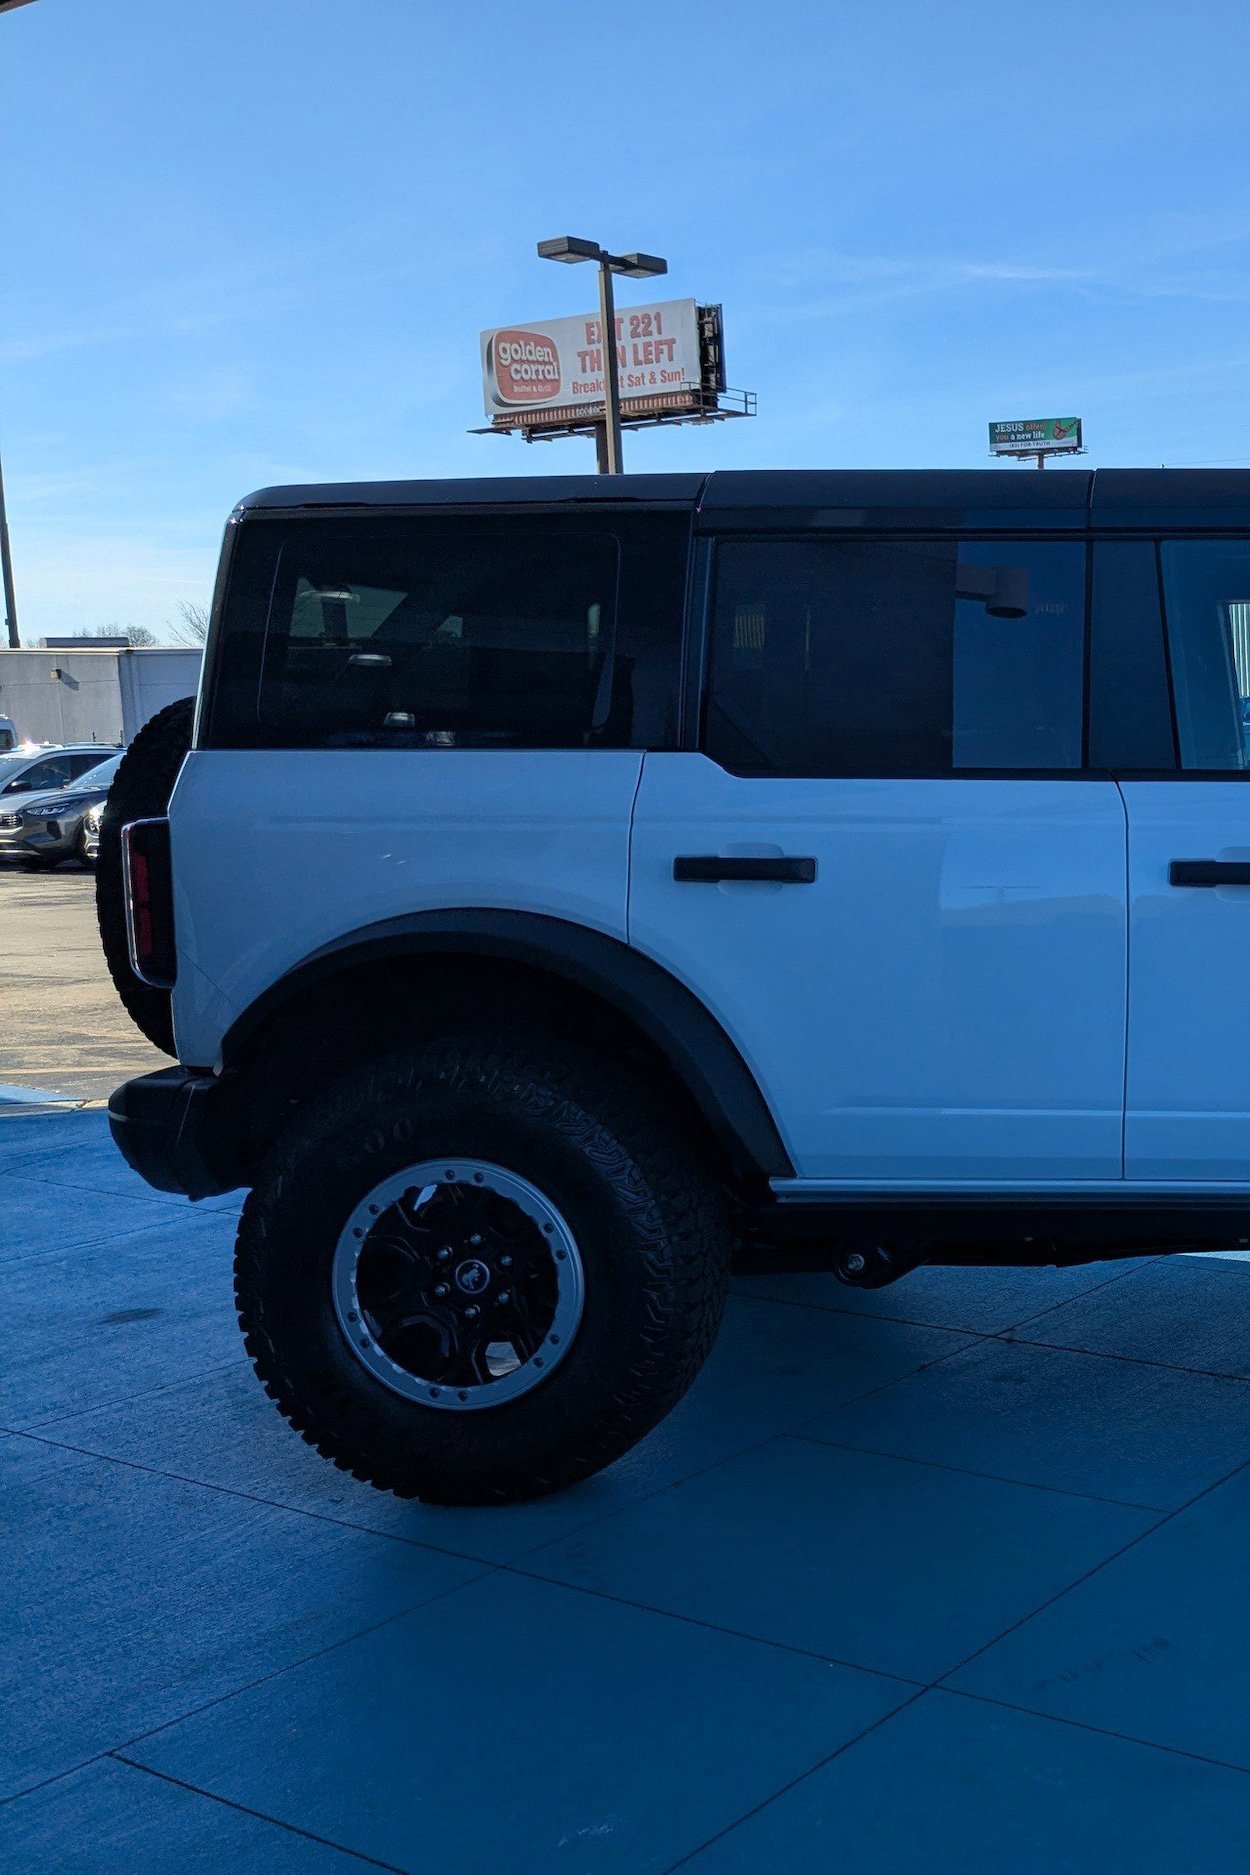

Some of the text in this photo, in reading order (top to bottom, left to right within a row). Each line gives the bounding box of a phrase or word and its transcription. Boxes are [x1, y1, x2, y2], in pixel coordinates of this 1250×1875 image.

[585, 311, 663, 345] EXT 221
[499, 340, 554, 366] golden
[577, 338, 677, 373] THN LEFT
[511, 362, 560, 381] corral
[571, 367, 686, 395] Breakt Sat & Sun!
[995, 422, 1024, 433] JESUS
[1032, 431, 1045, 439] life
